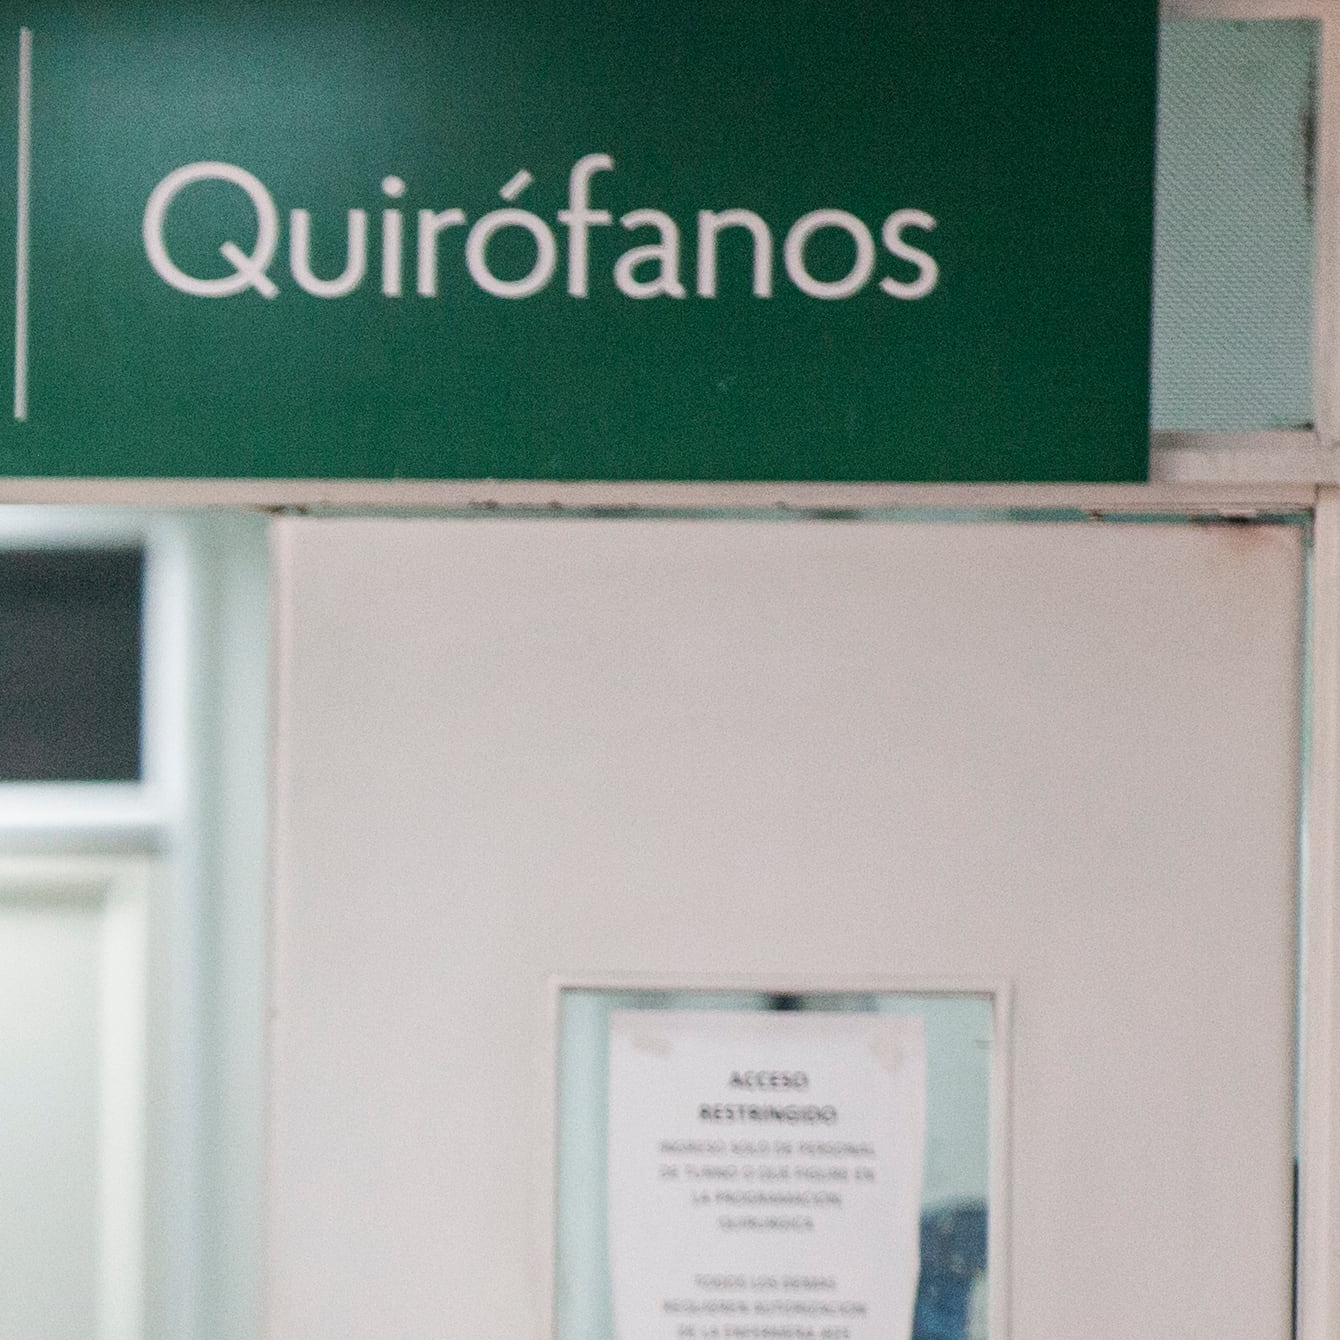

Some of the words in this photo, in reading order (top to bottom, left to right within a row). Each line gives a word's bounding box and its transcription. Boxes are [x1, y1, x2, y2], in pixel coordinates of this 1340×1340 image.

[142, 153, 939, 300] Quirófanos
[729, 1070, 809, 1090] ACCESO
[698, 1103, 838, 1124] RESTRINGIDO
